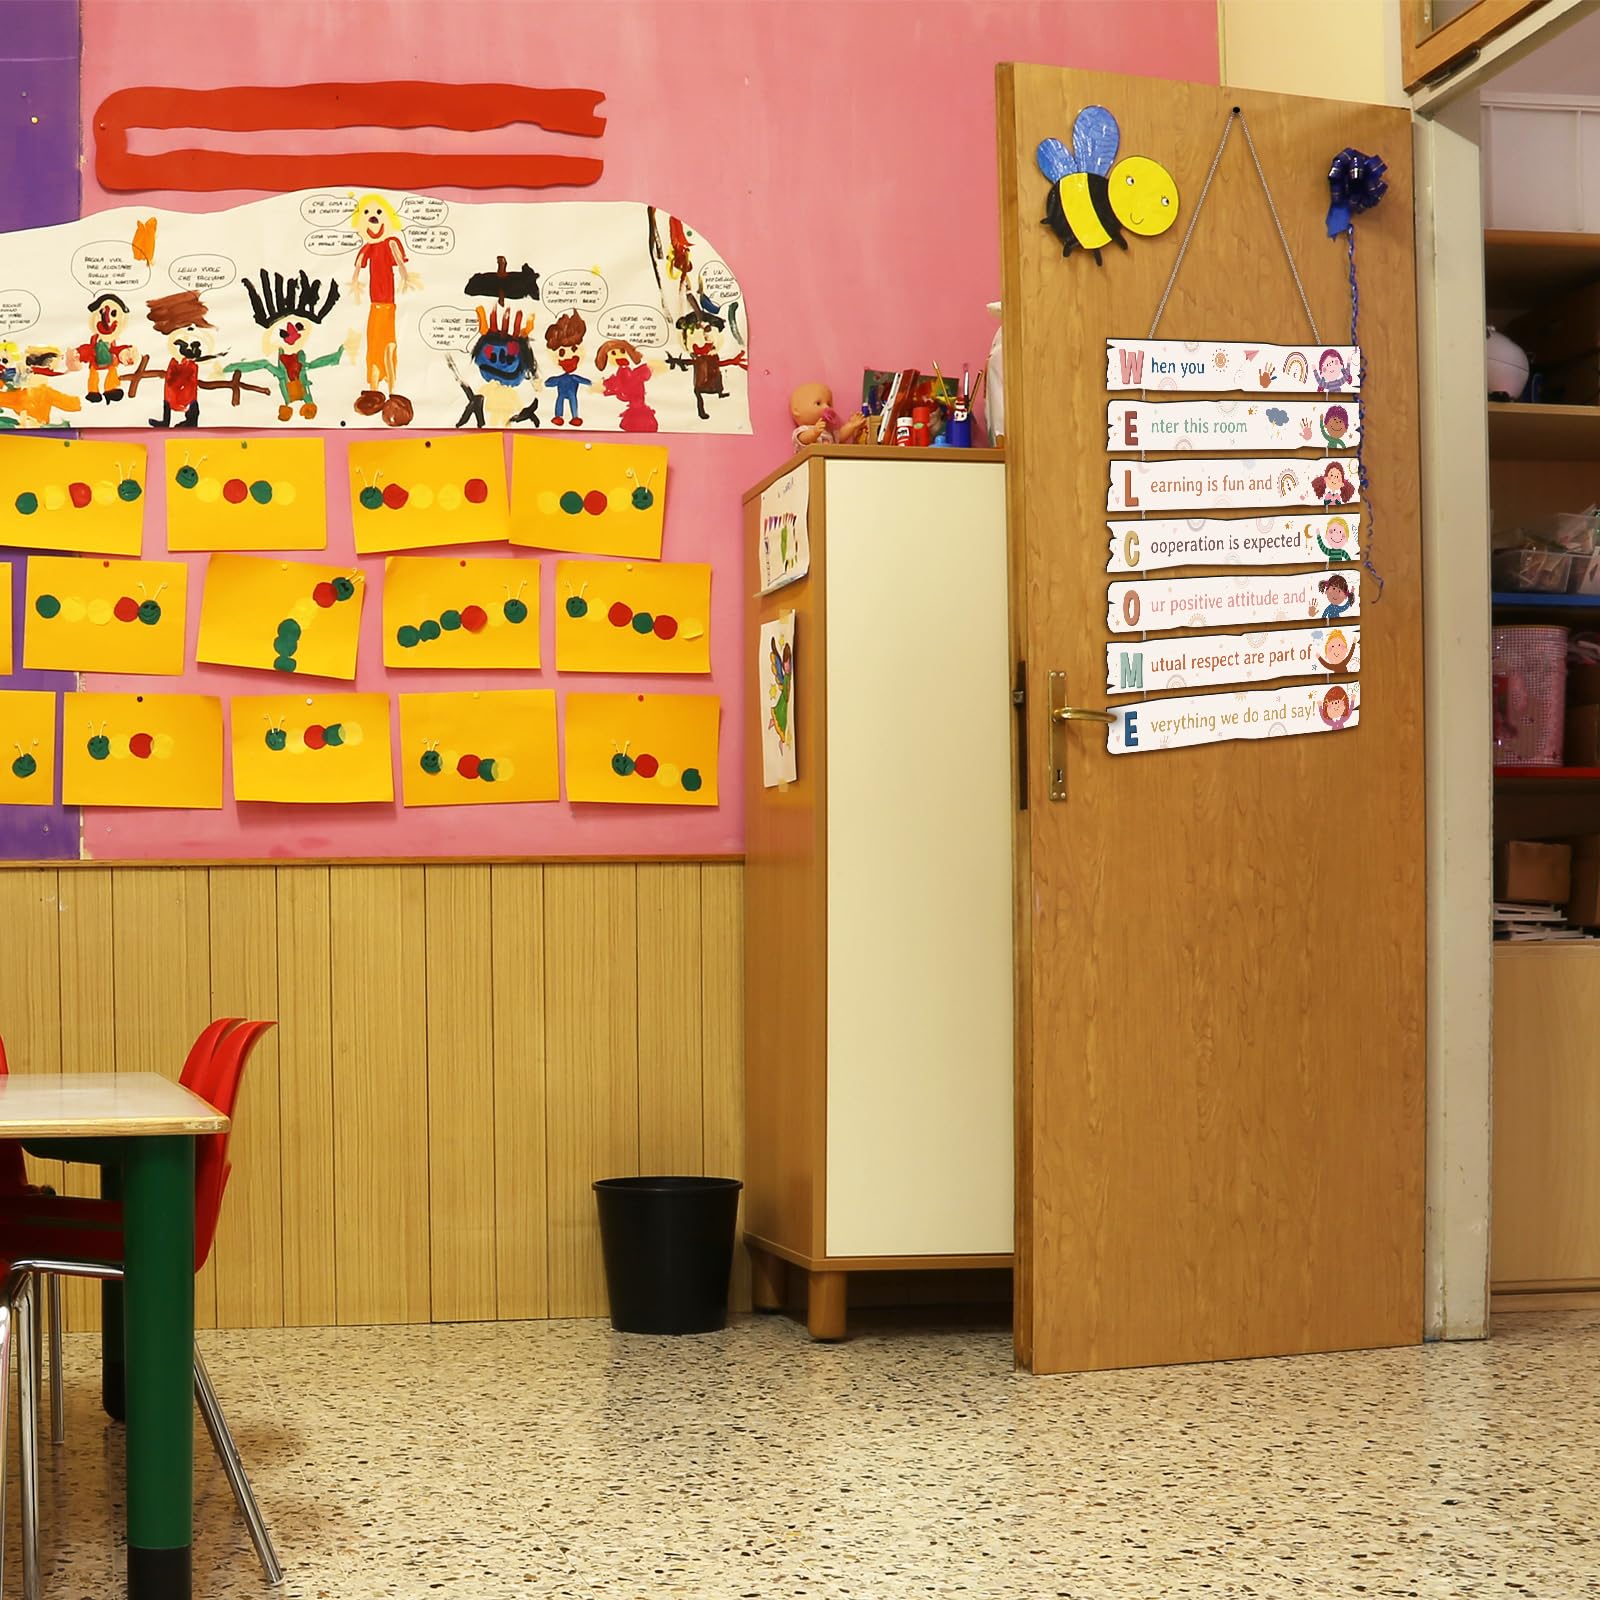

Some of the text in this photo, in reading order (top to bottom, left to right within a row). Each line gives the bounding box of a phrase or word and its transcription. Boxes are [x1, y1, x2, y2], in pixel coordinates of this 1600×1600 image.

[1181, 361, 1205, 377] you
[1184, 418, 1209, 433] this
[1213, 422, 1248, 433] room
[1207, 476, 1218, 491] is
[1223, 475, 1244, 491] fun
[1249, 474, 1272, 491] and
[1229, 535, 1239, 550] is
[1243, 532, 1301, 551] expected
[1170, 594, 1222, 615] positive
[1227, 591, 1279, 609] attitude
[1283, 587, 1306, 605] and
[1191, 652, 1240, 672] respect
[1243, 653, 1265, 665] are
[1269, 647, 1295, 666] part
[1299, 644, 1313, 660] of
[1220, 711, 1239, 725] we
[1243, 707, 1259, 723] do
[1263, 704, 1287, 721] and
[1291, 701, 1316, 721] say!
